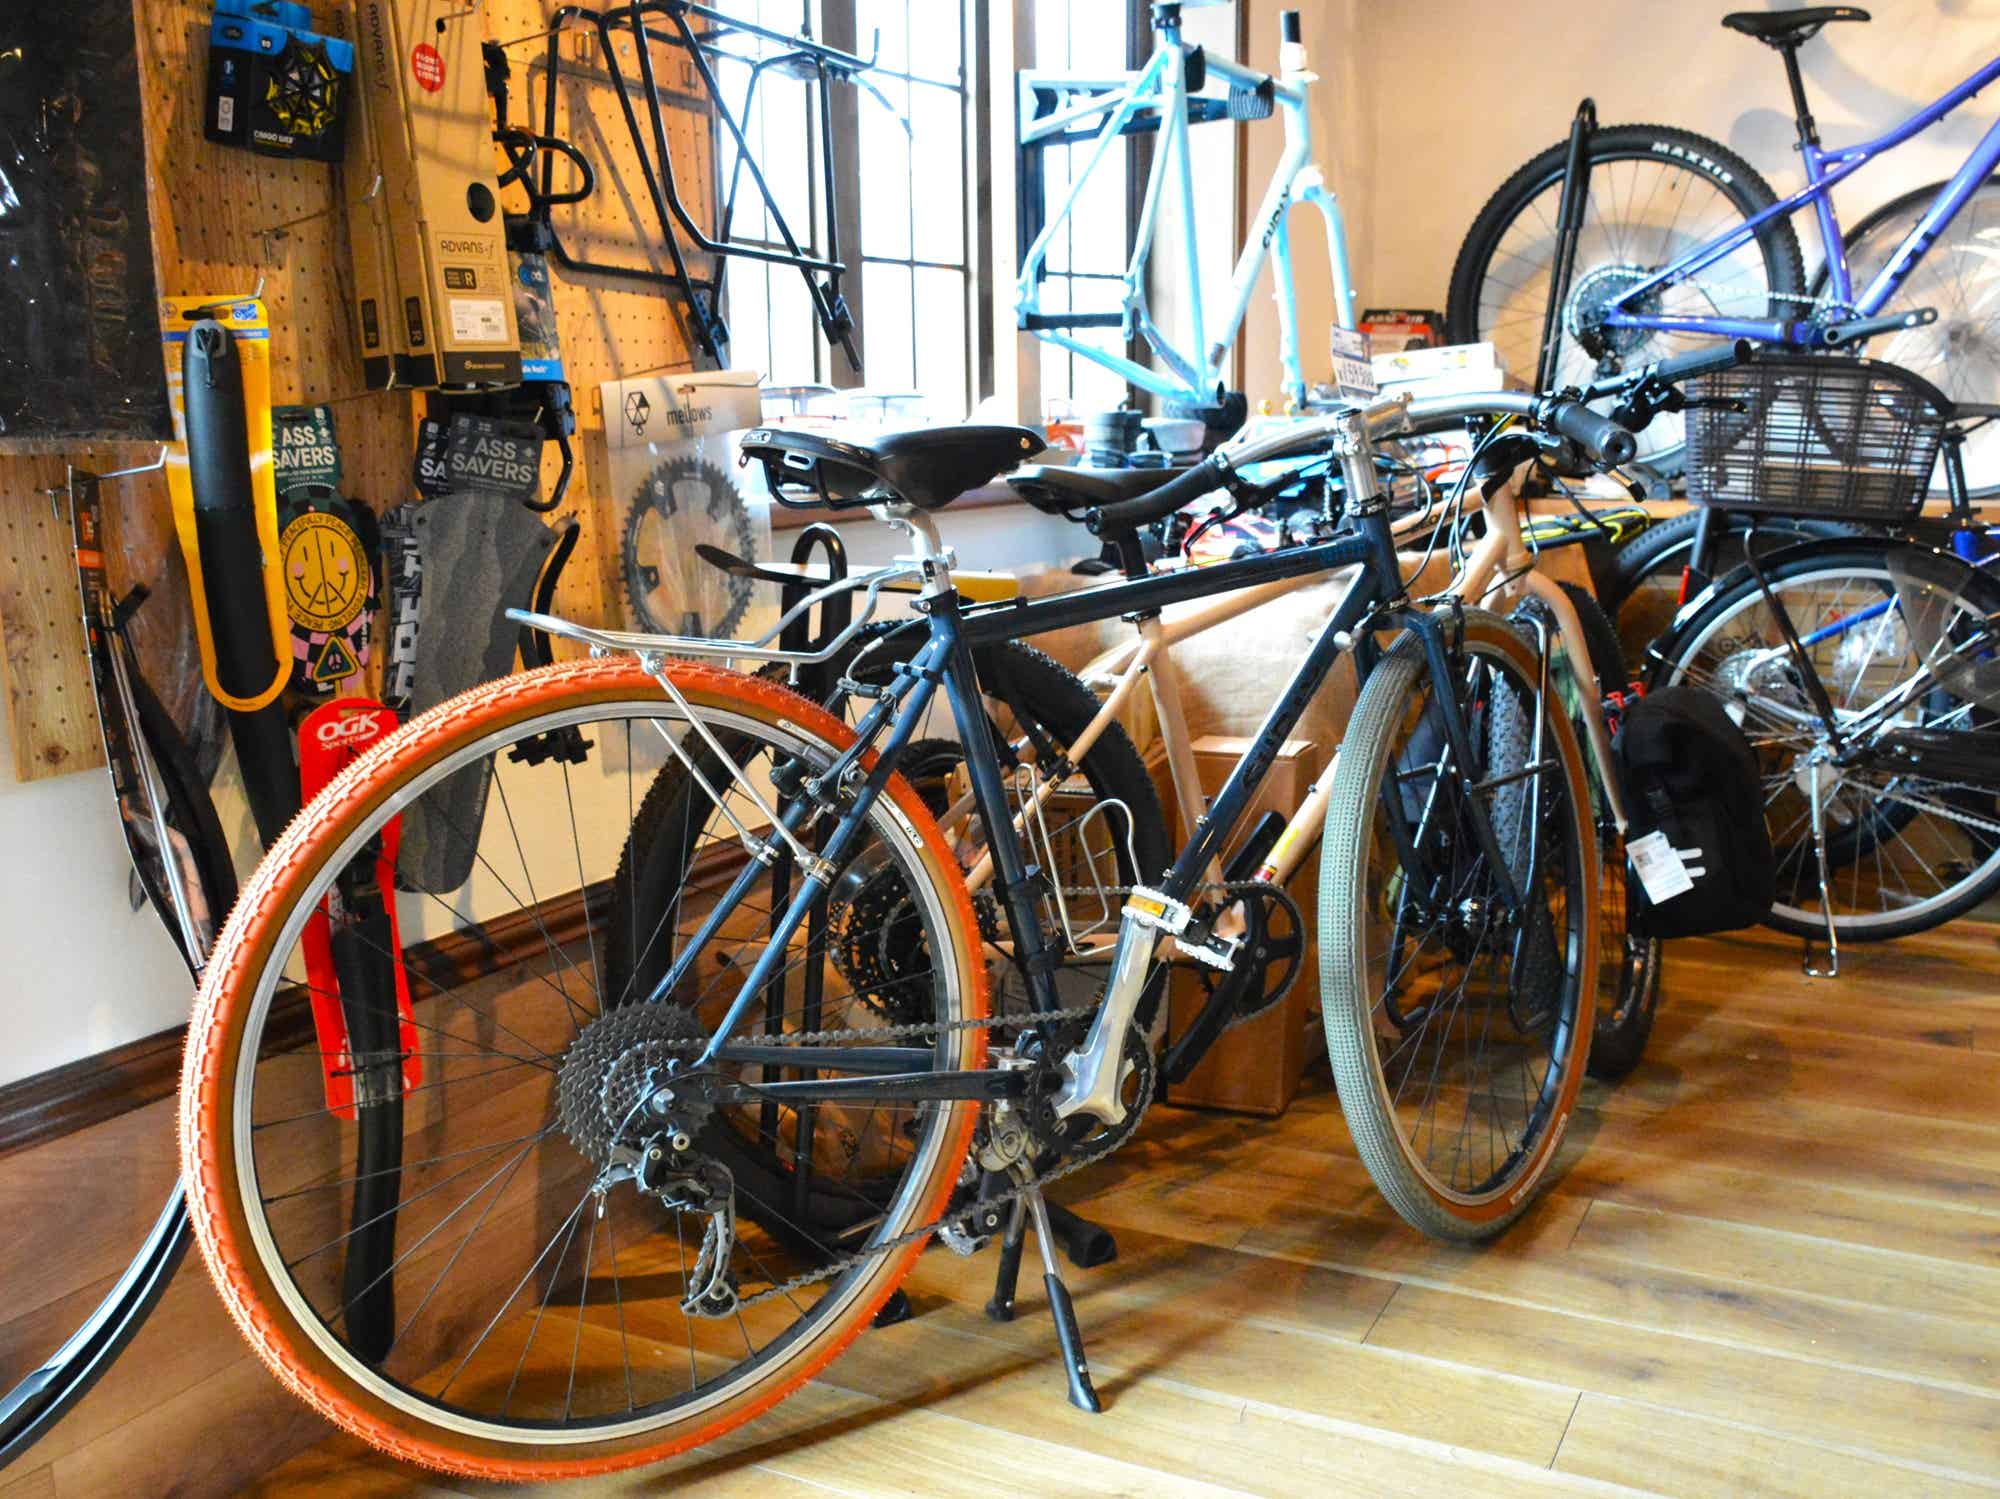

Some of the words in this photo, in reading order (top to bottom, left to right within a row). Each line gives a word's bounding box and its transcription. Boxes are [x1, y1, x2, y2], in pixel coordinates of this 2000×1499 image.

[1651, 141, 1733, 184] MAXXIS
[666, 404, 713, 426] mellows
[281, 425, 317, 447] ASS
[272, 445, 336, 469] SAVERS
[474, 437, 517, 460] ASS
[451, 452, 533, 483] SAVERS
[317, 709, 381, 741] OGK
